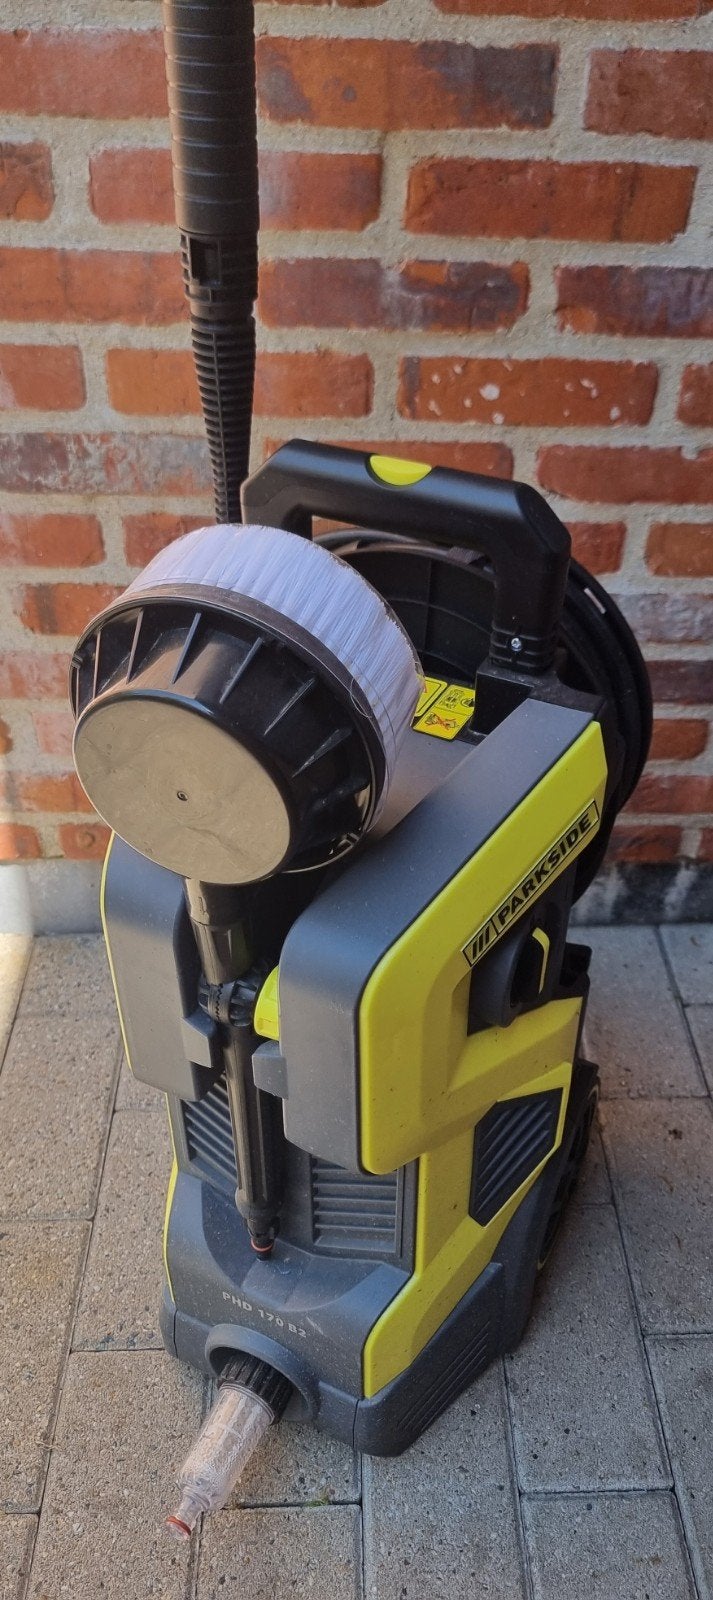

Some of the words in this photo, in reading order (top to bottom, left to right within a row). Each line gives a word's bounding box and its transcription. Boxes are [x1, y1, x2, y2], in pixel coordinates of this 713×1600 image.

[497, 812, 592, 927] PARKSIDE
[222, 1291, 253, 1312] PHD
[258, 1308, 284, 1328] 170
[287, 1322, 307, 1338] B2
